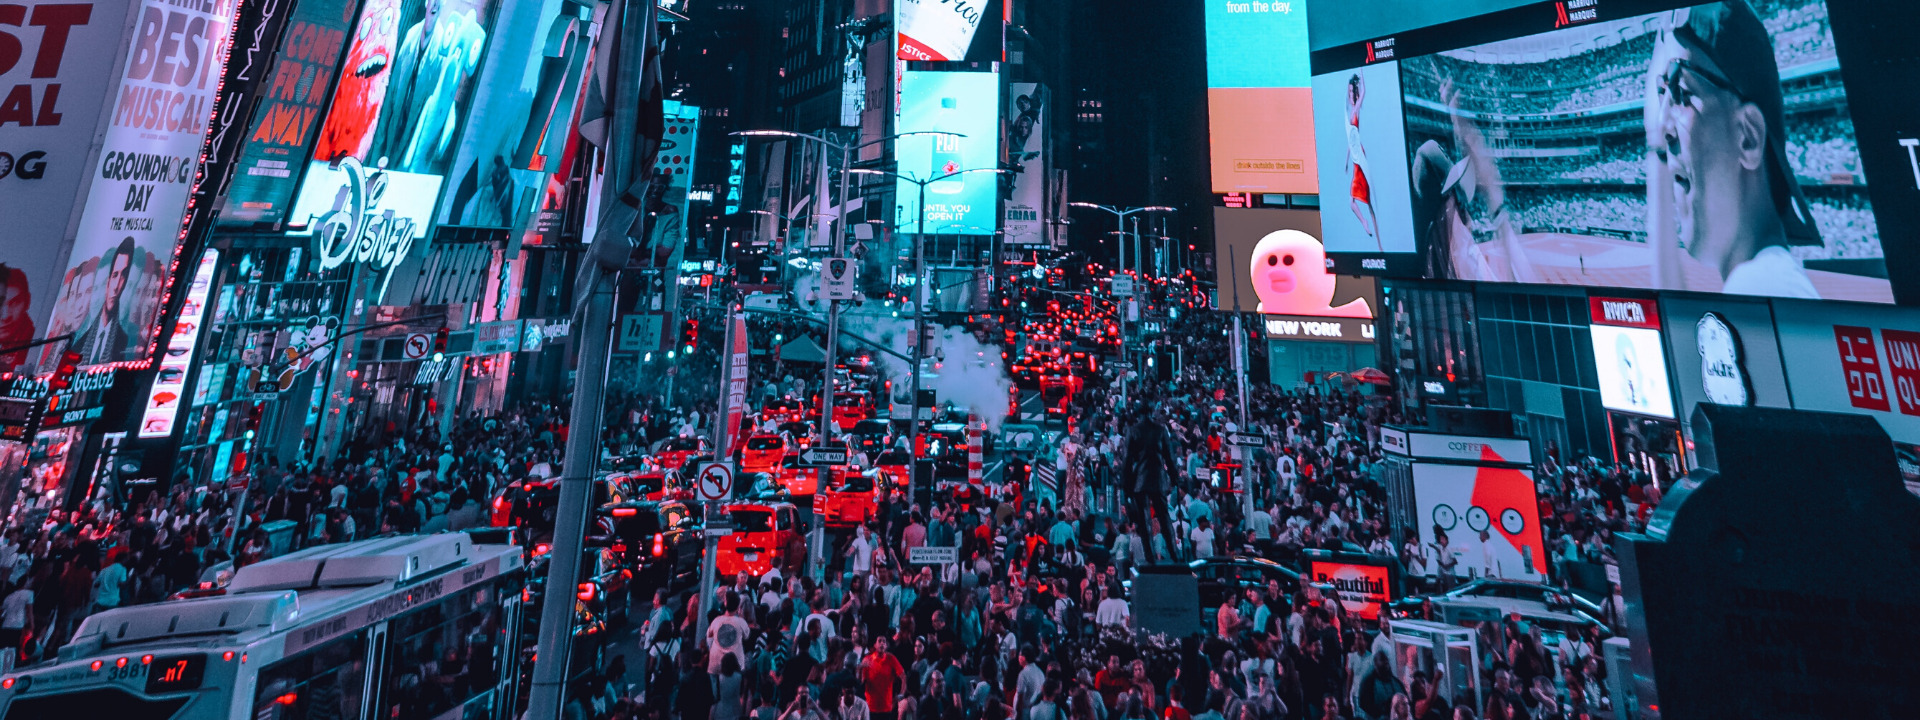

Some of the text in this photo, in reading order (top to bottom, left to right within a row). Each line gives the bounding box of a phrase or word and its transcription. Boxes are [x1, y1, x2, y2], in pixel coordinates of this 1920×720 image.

[1226, 1, 1292, 14] from the day.
[1569, 8, 1597, 21] MARQUIS
[127, 5, 226, 90] BEST
[287, 21, 345, 67] COME
[1374, 37, 1395, 48] MARRIOTT
[1375, 48, 1394, 58] MARQUIS
[269, 60, 331, 105] FROM
[114, 84, 205, 134] MUSICAL
[252, 103, 318, 147] AWAY
[936, 134, 958, 151] FIJI
[102, 151, 190, 183] GROUNDHOG
[124, 184, 155, 212] DAY
[927, 212, 964, 221] OPEN IT
[951, 204, 970, 212] YOU
[110, 217, 153, 231] THE MUSICAL
[1266, 320, 1342, 337] NEW YORK
[62, 408, 86, 423] SONY
[813, 452, 844, 461] ONE WAY
[1317, 572, 1384, 594] Beautiful
[107, 662, 148, 681] 3881
